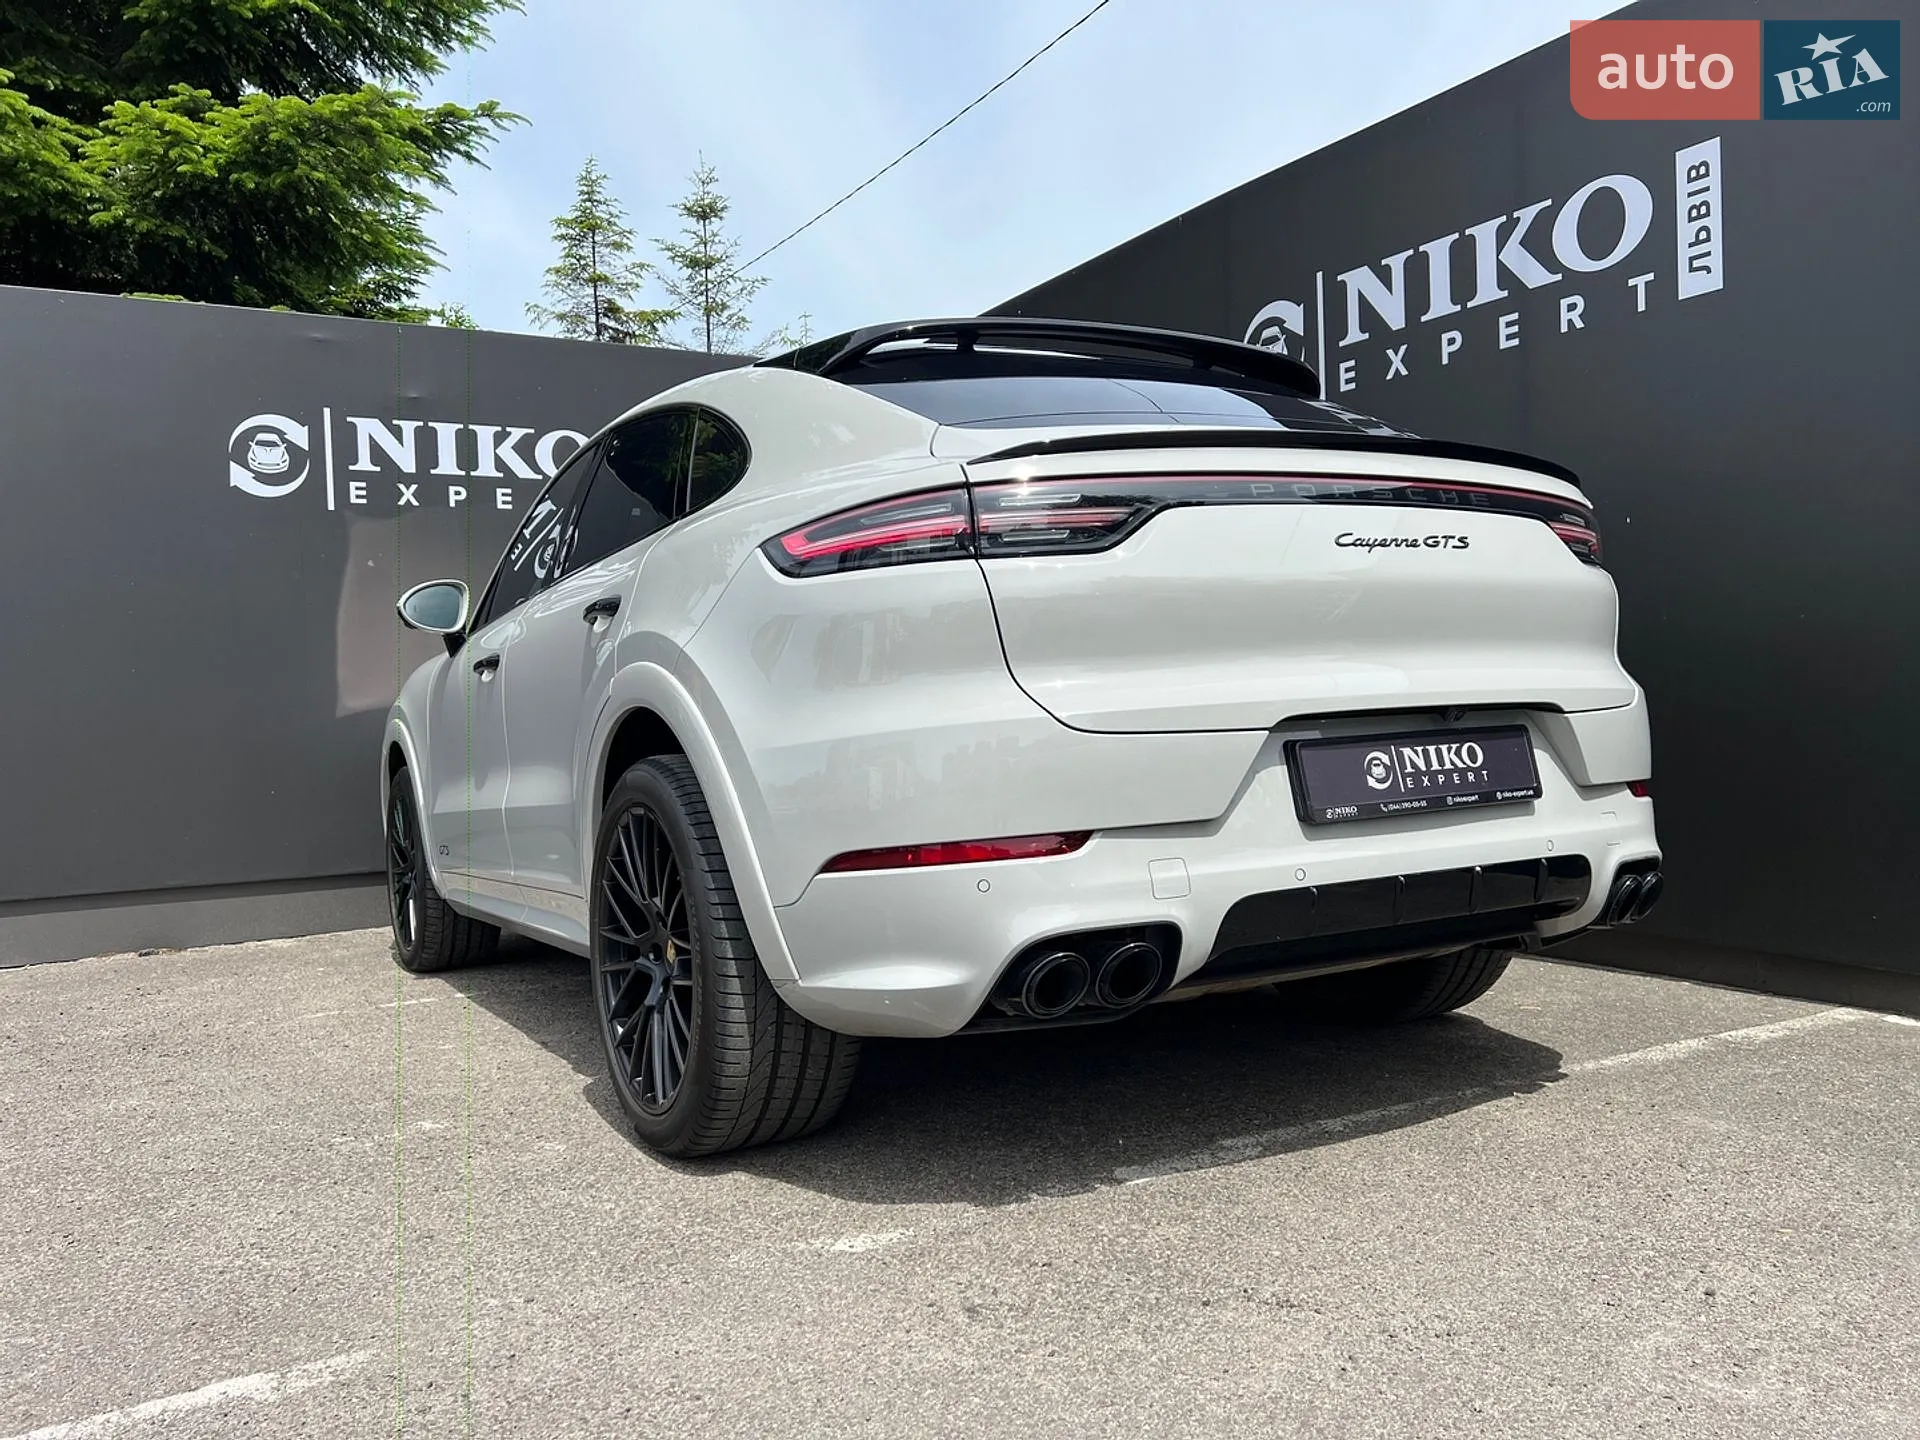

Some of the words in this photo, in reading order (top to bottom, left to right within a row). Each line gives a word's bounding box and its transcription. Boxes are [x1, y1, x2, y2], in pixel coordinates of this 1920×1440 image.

[1686, 159, 1712, 275] ЛЬВІВ
[1337, 174, 1653, 348] NIKO
[1340, 272, 1655, 392] EXPERT
[346, 416, 590, 480] NIKO
[1251, 483, 1490, 506] PORSCHE
[1334, 532, 1421, 554] Cayenne
[1423, 535, 1470, 549] GTS
[1399, 742, 1484, 773] NIKO
[1406, 770, 1488, 788] EXPERT
